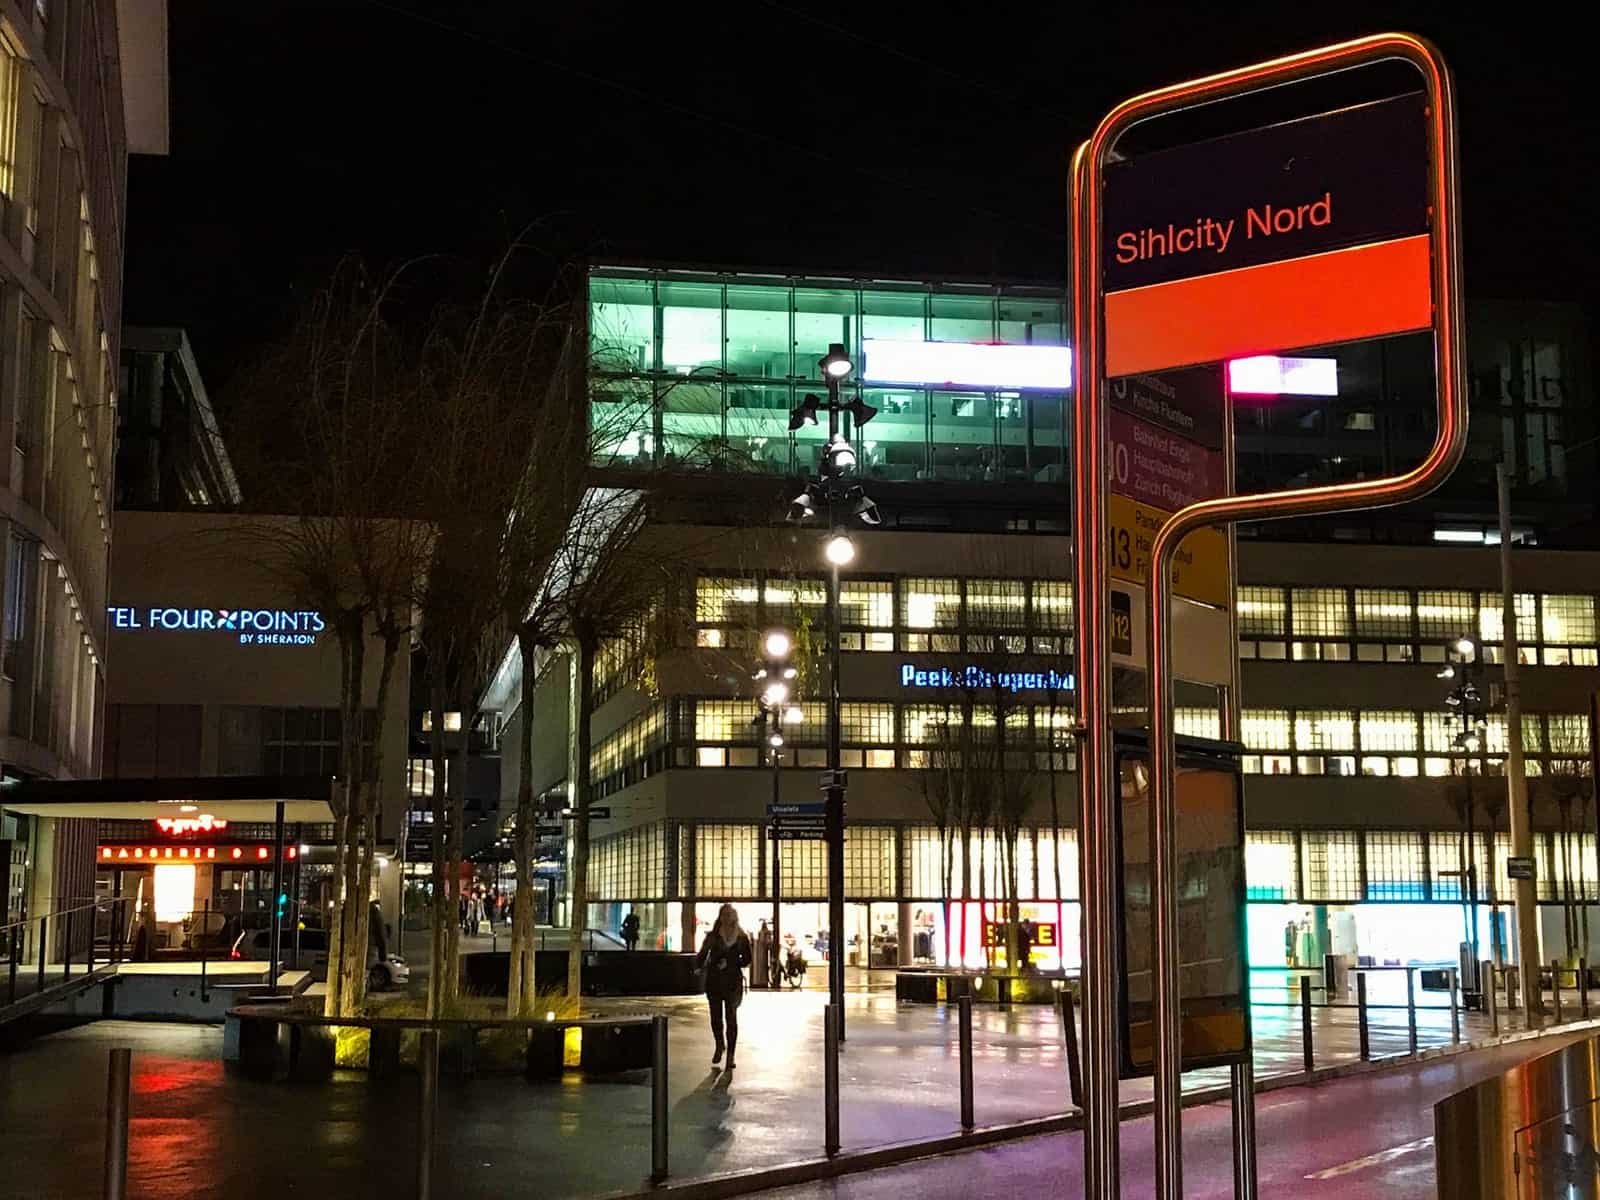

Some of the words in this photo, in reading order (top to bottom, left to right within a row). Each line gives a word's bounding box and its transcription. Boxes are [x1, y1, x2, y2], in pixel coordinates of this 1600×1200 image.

[1116, 217, 1234, 264] Sihlcity
[1247, 192, 1331, 239] Nord
[1110, 526, 1130, 570] 13
[150, 608, 216, 629] FOUR
[240, 609, 326, 631] POINTS
[240, 634, 254, 644] BY
[257, 634, 316, 645] SHERATON
[986, 925, 1053, 944] SE
